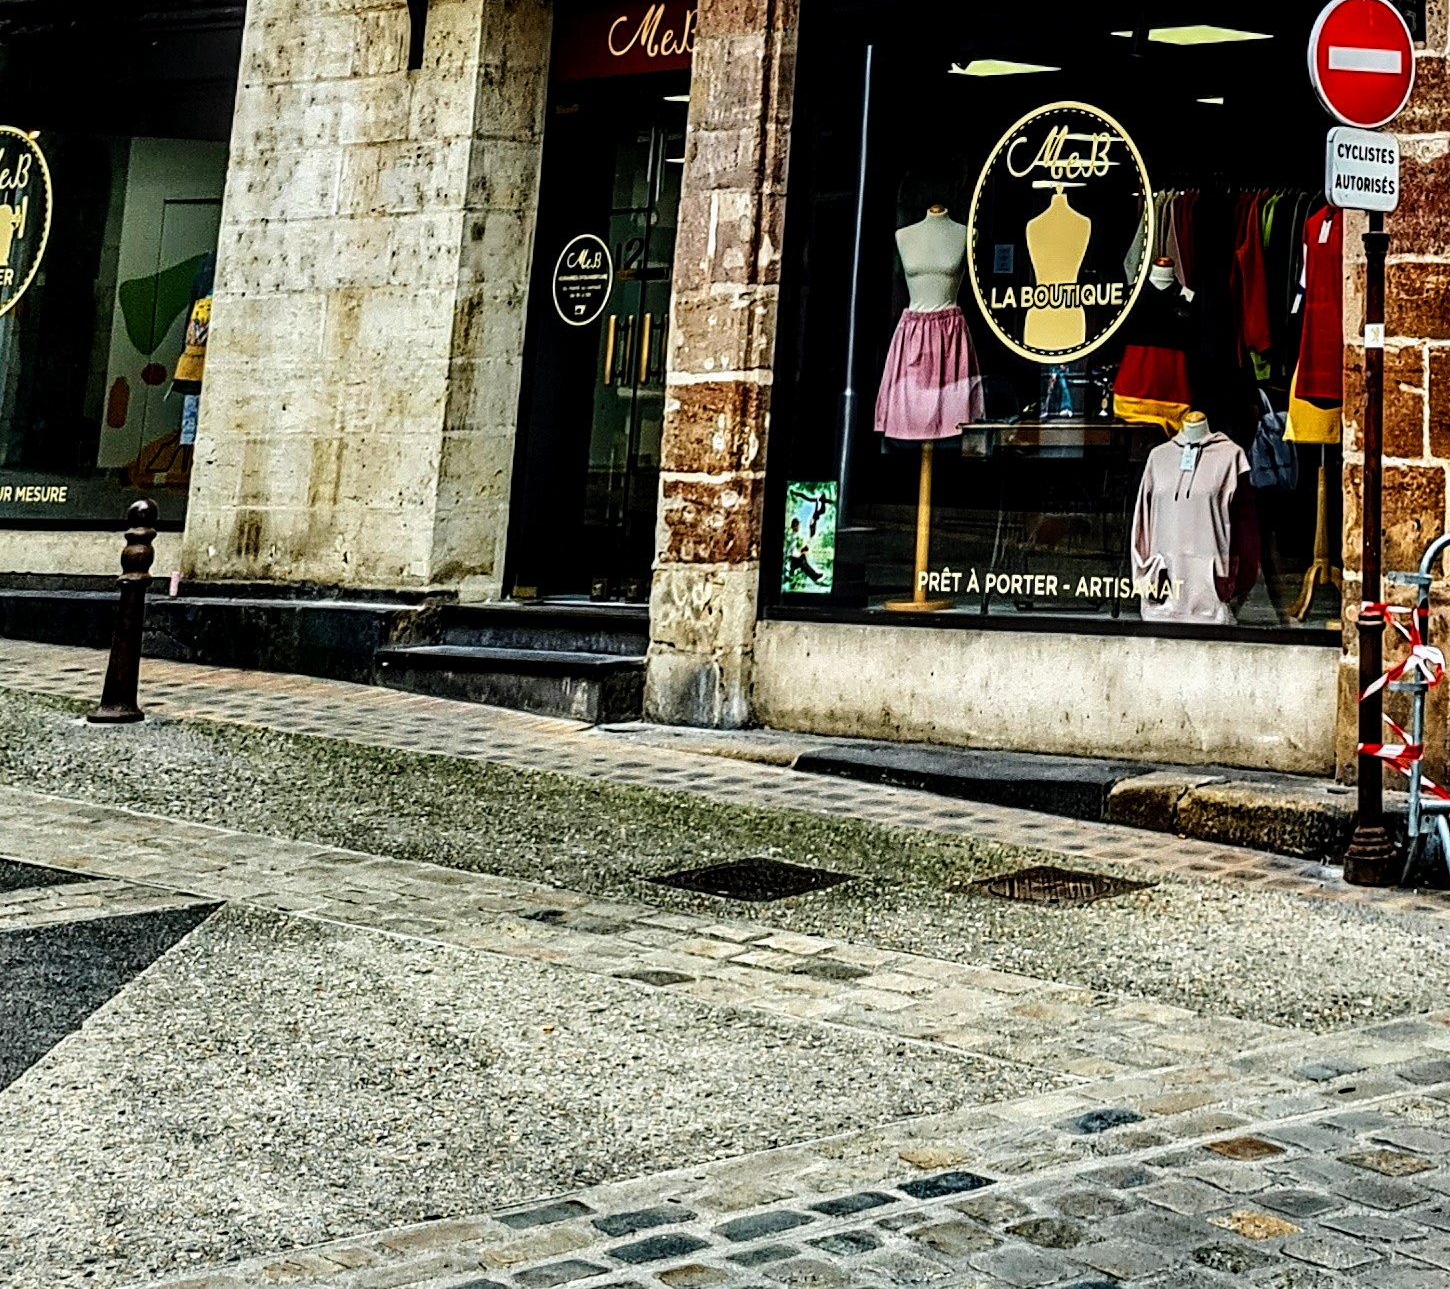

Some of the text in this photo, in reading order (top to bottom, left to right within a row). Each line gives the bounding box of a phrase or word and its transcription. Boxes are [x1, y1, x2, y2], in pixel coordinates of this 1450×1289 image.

[1006, 124, 1112, 180] MeB
[1337, 143, 1395, 165] CYCLISTES
[0, 147, 32, 190] eB
[1335, 173, 1396, 195] AUTORISÉS
[991, 282, 1124, 309] LA BOUTIQUE
[14, 485, 68, 503] MESURE
[917, 566, 962, 592] PRÊT
[966, 567, 980, 593] À
[985, 573, 1058, 596] PORTER
[1075, 576, 1184, 600] ARTISANAT
